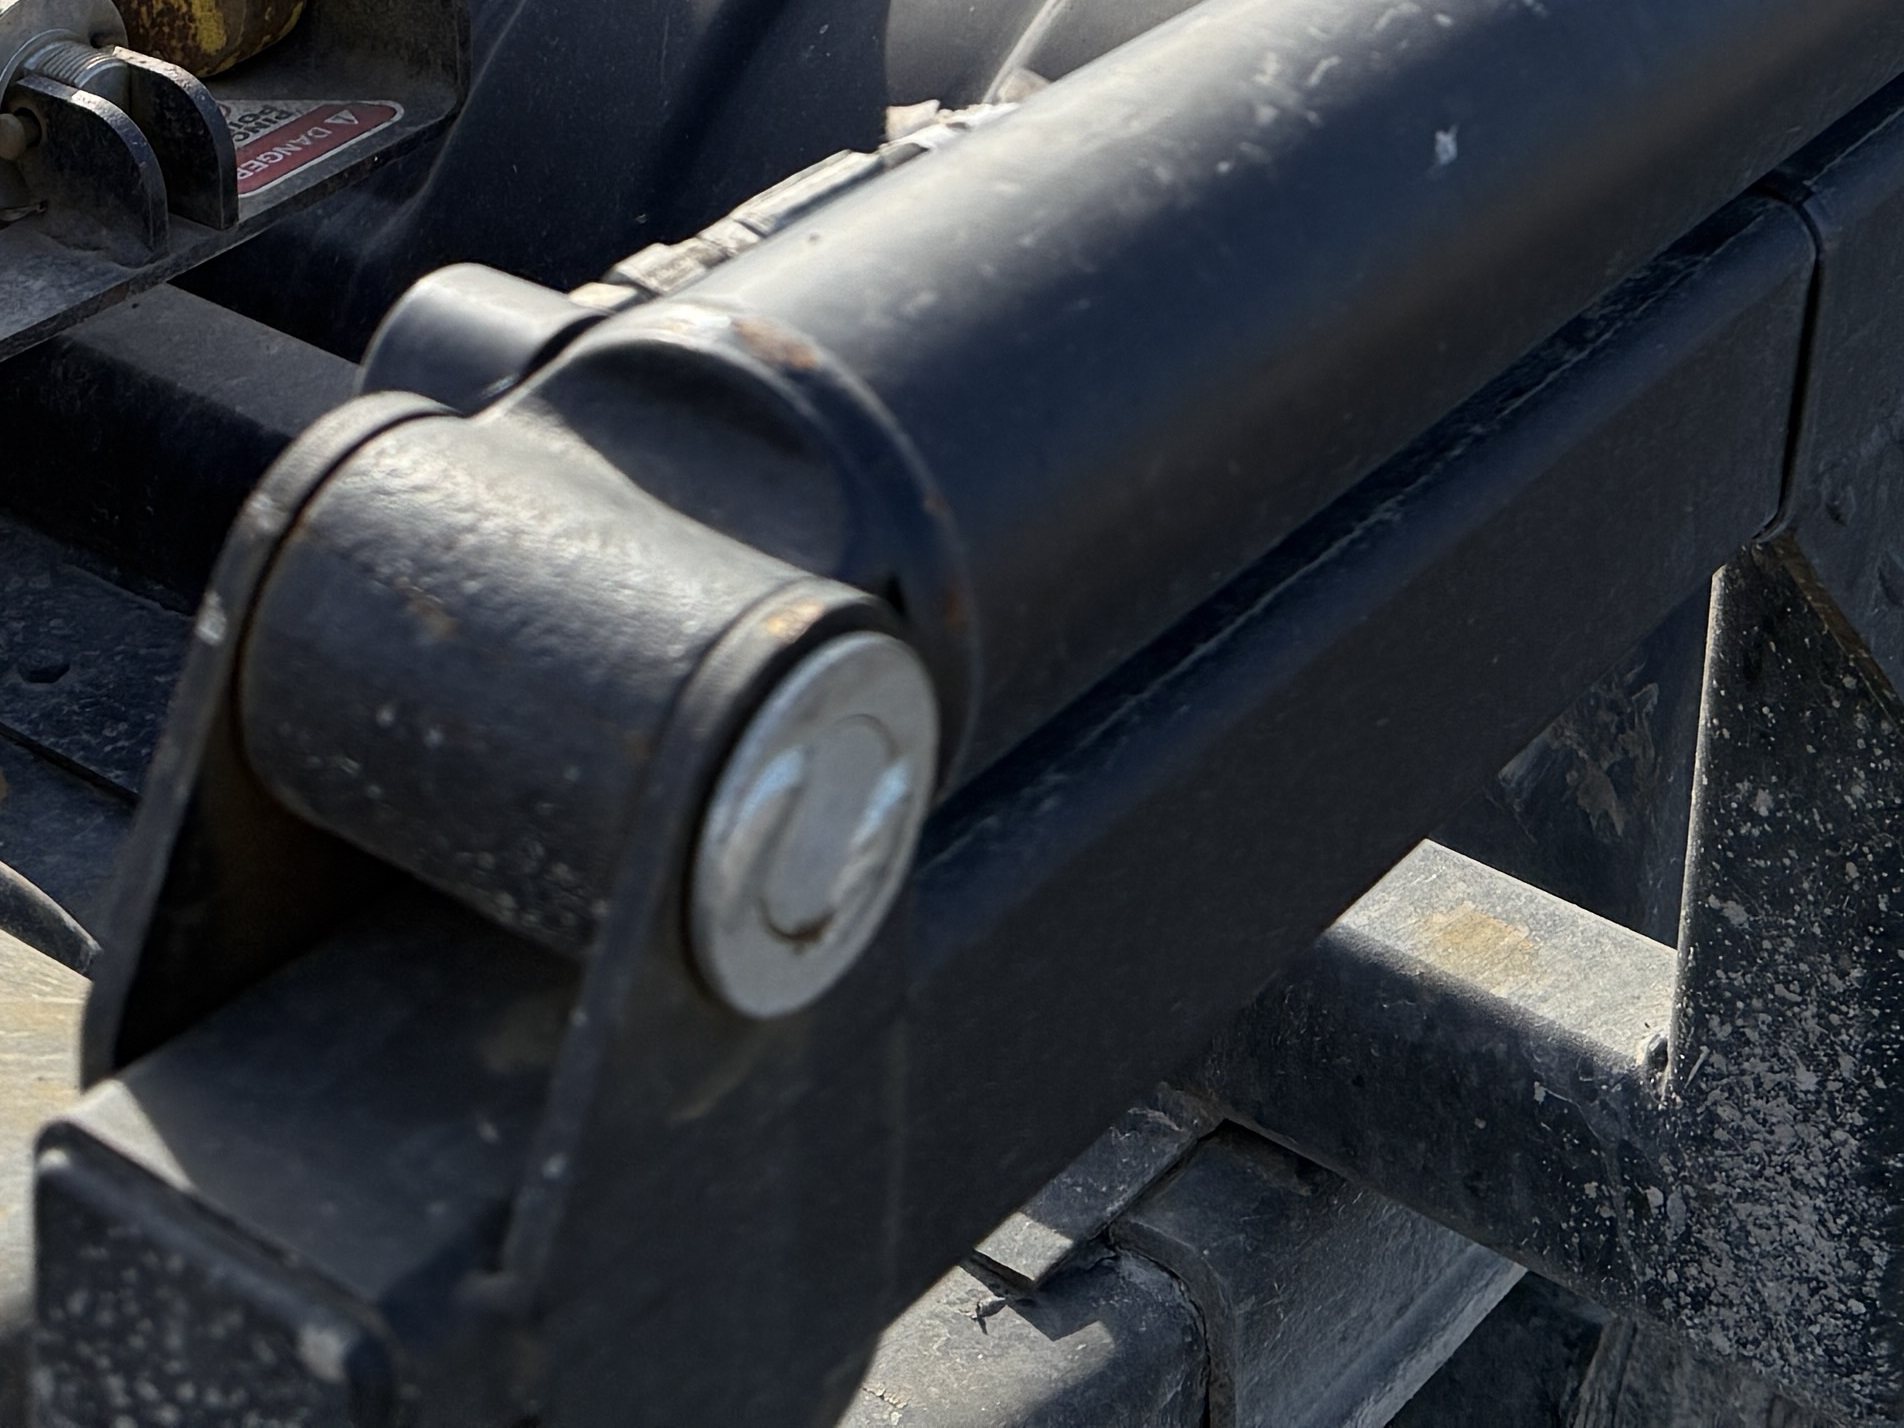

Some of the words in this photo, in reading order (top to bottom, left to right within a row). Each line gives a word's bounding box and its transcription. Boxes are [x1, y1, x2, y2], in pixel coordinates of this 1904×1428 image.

[228, 104, 278, 130] POI
[232, 109, 292, 142] PINC
[236, 126, 333, 180] DANGER
